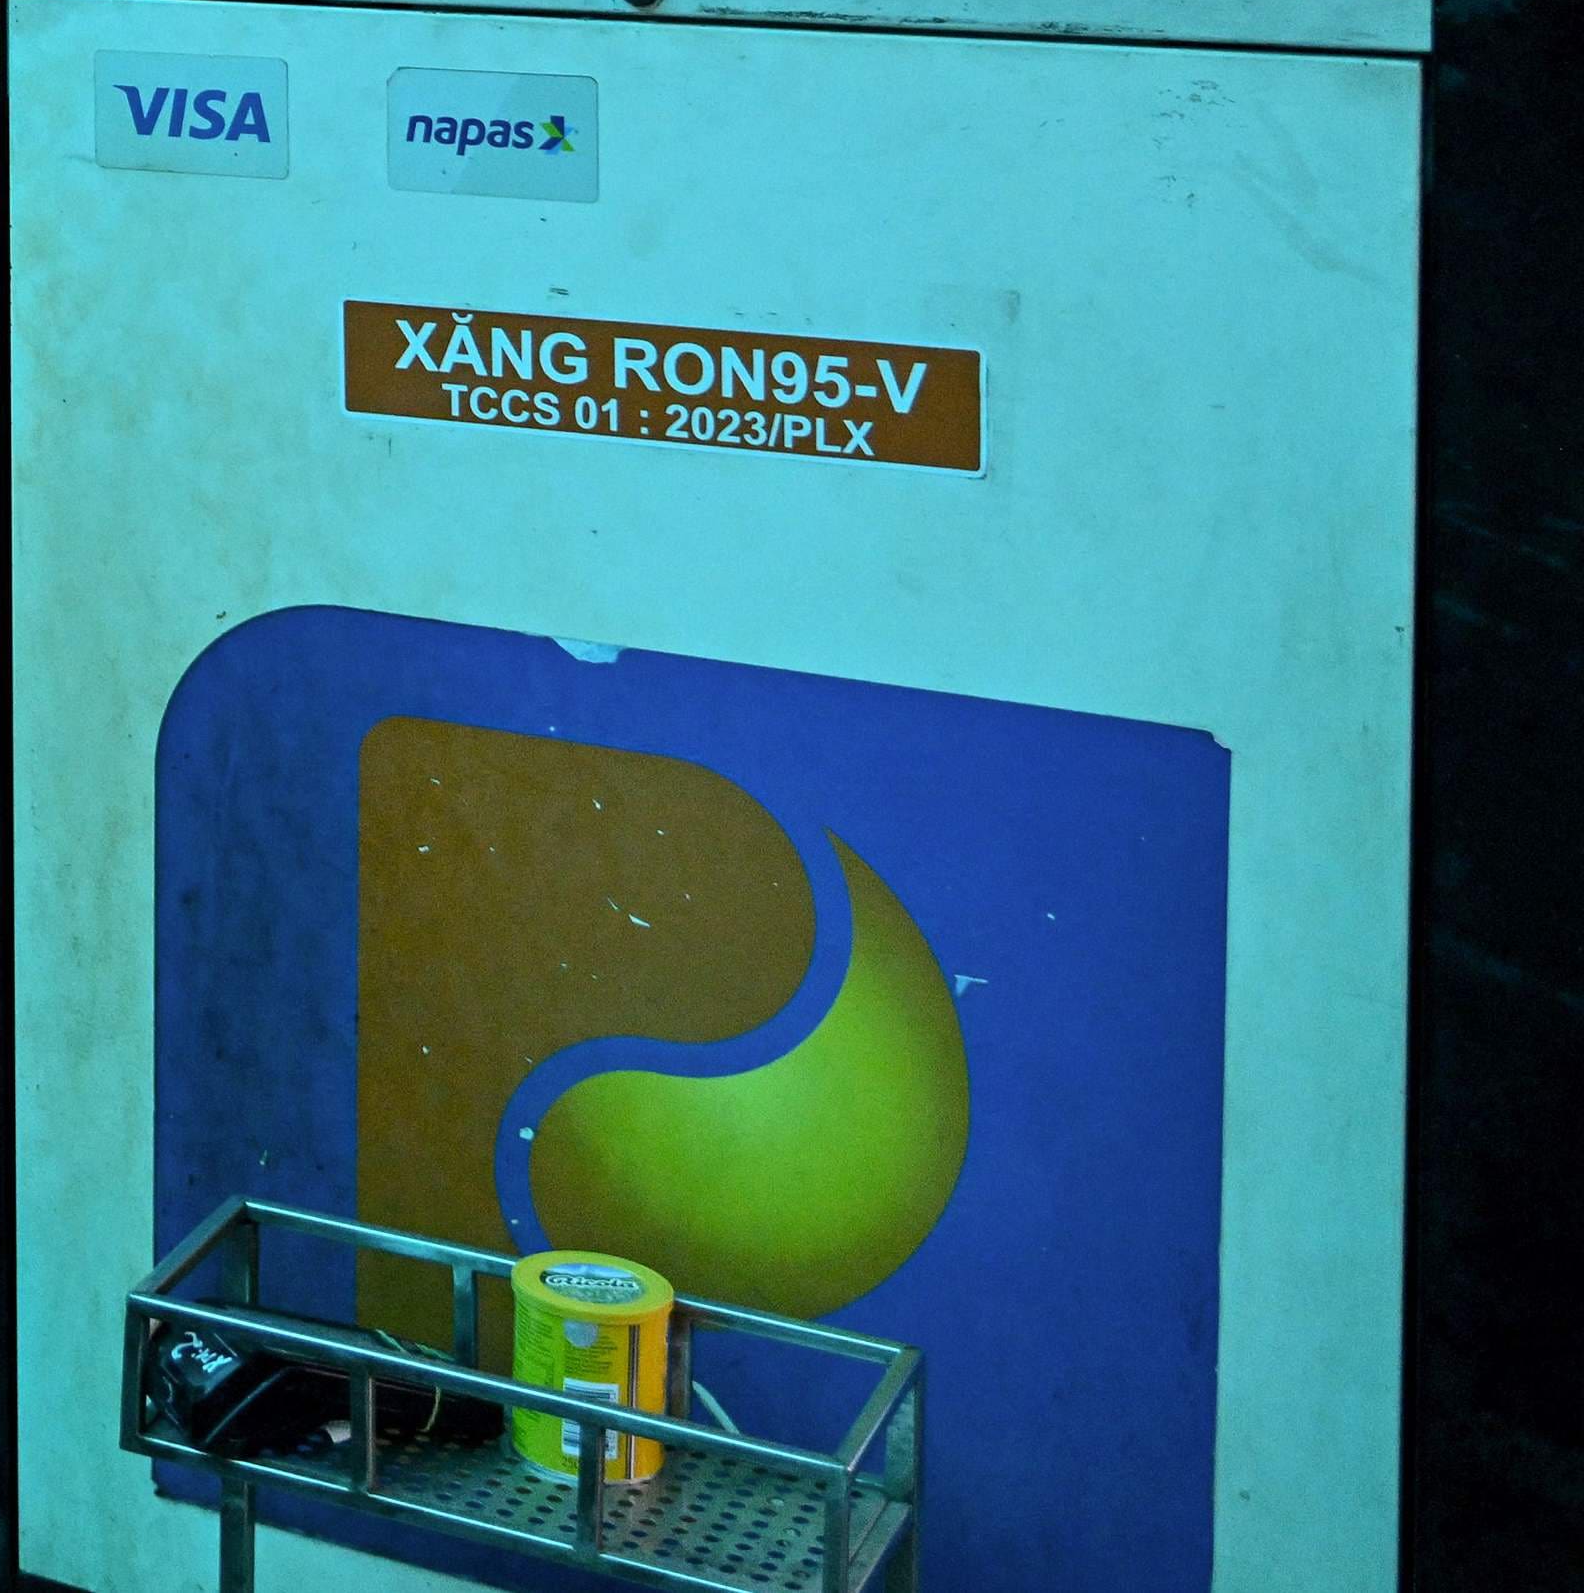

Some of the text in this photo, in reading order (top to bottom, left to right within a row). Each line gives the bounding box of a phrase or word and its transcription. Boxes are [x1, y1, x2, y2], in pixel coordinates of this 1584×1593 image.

[112, 84, 271, 142] VISA
[406, 114, 533, 155] napas
[395, 311, 927, 414] XĂNG RON95-V
[442, 383, 560, 432] TCCS
[574, 396, 621, 433] 01
[665, 404, 876, 457] 2023/PLX
